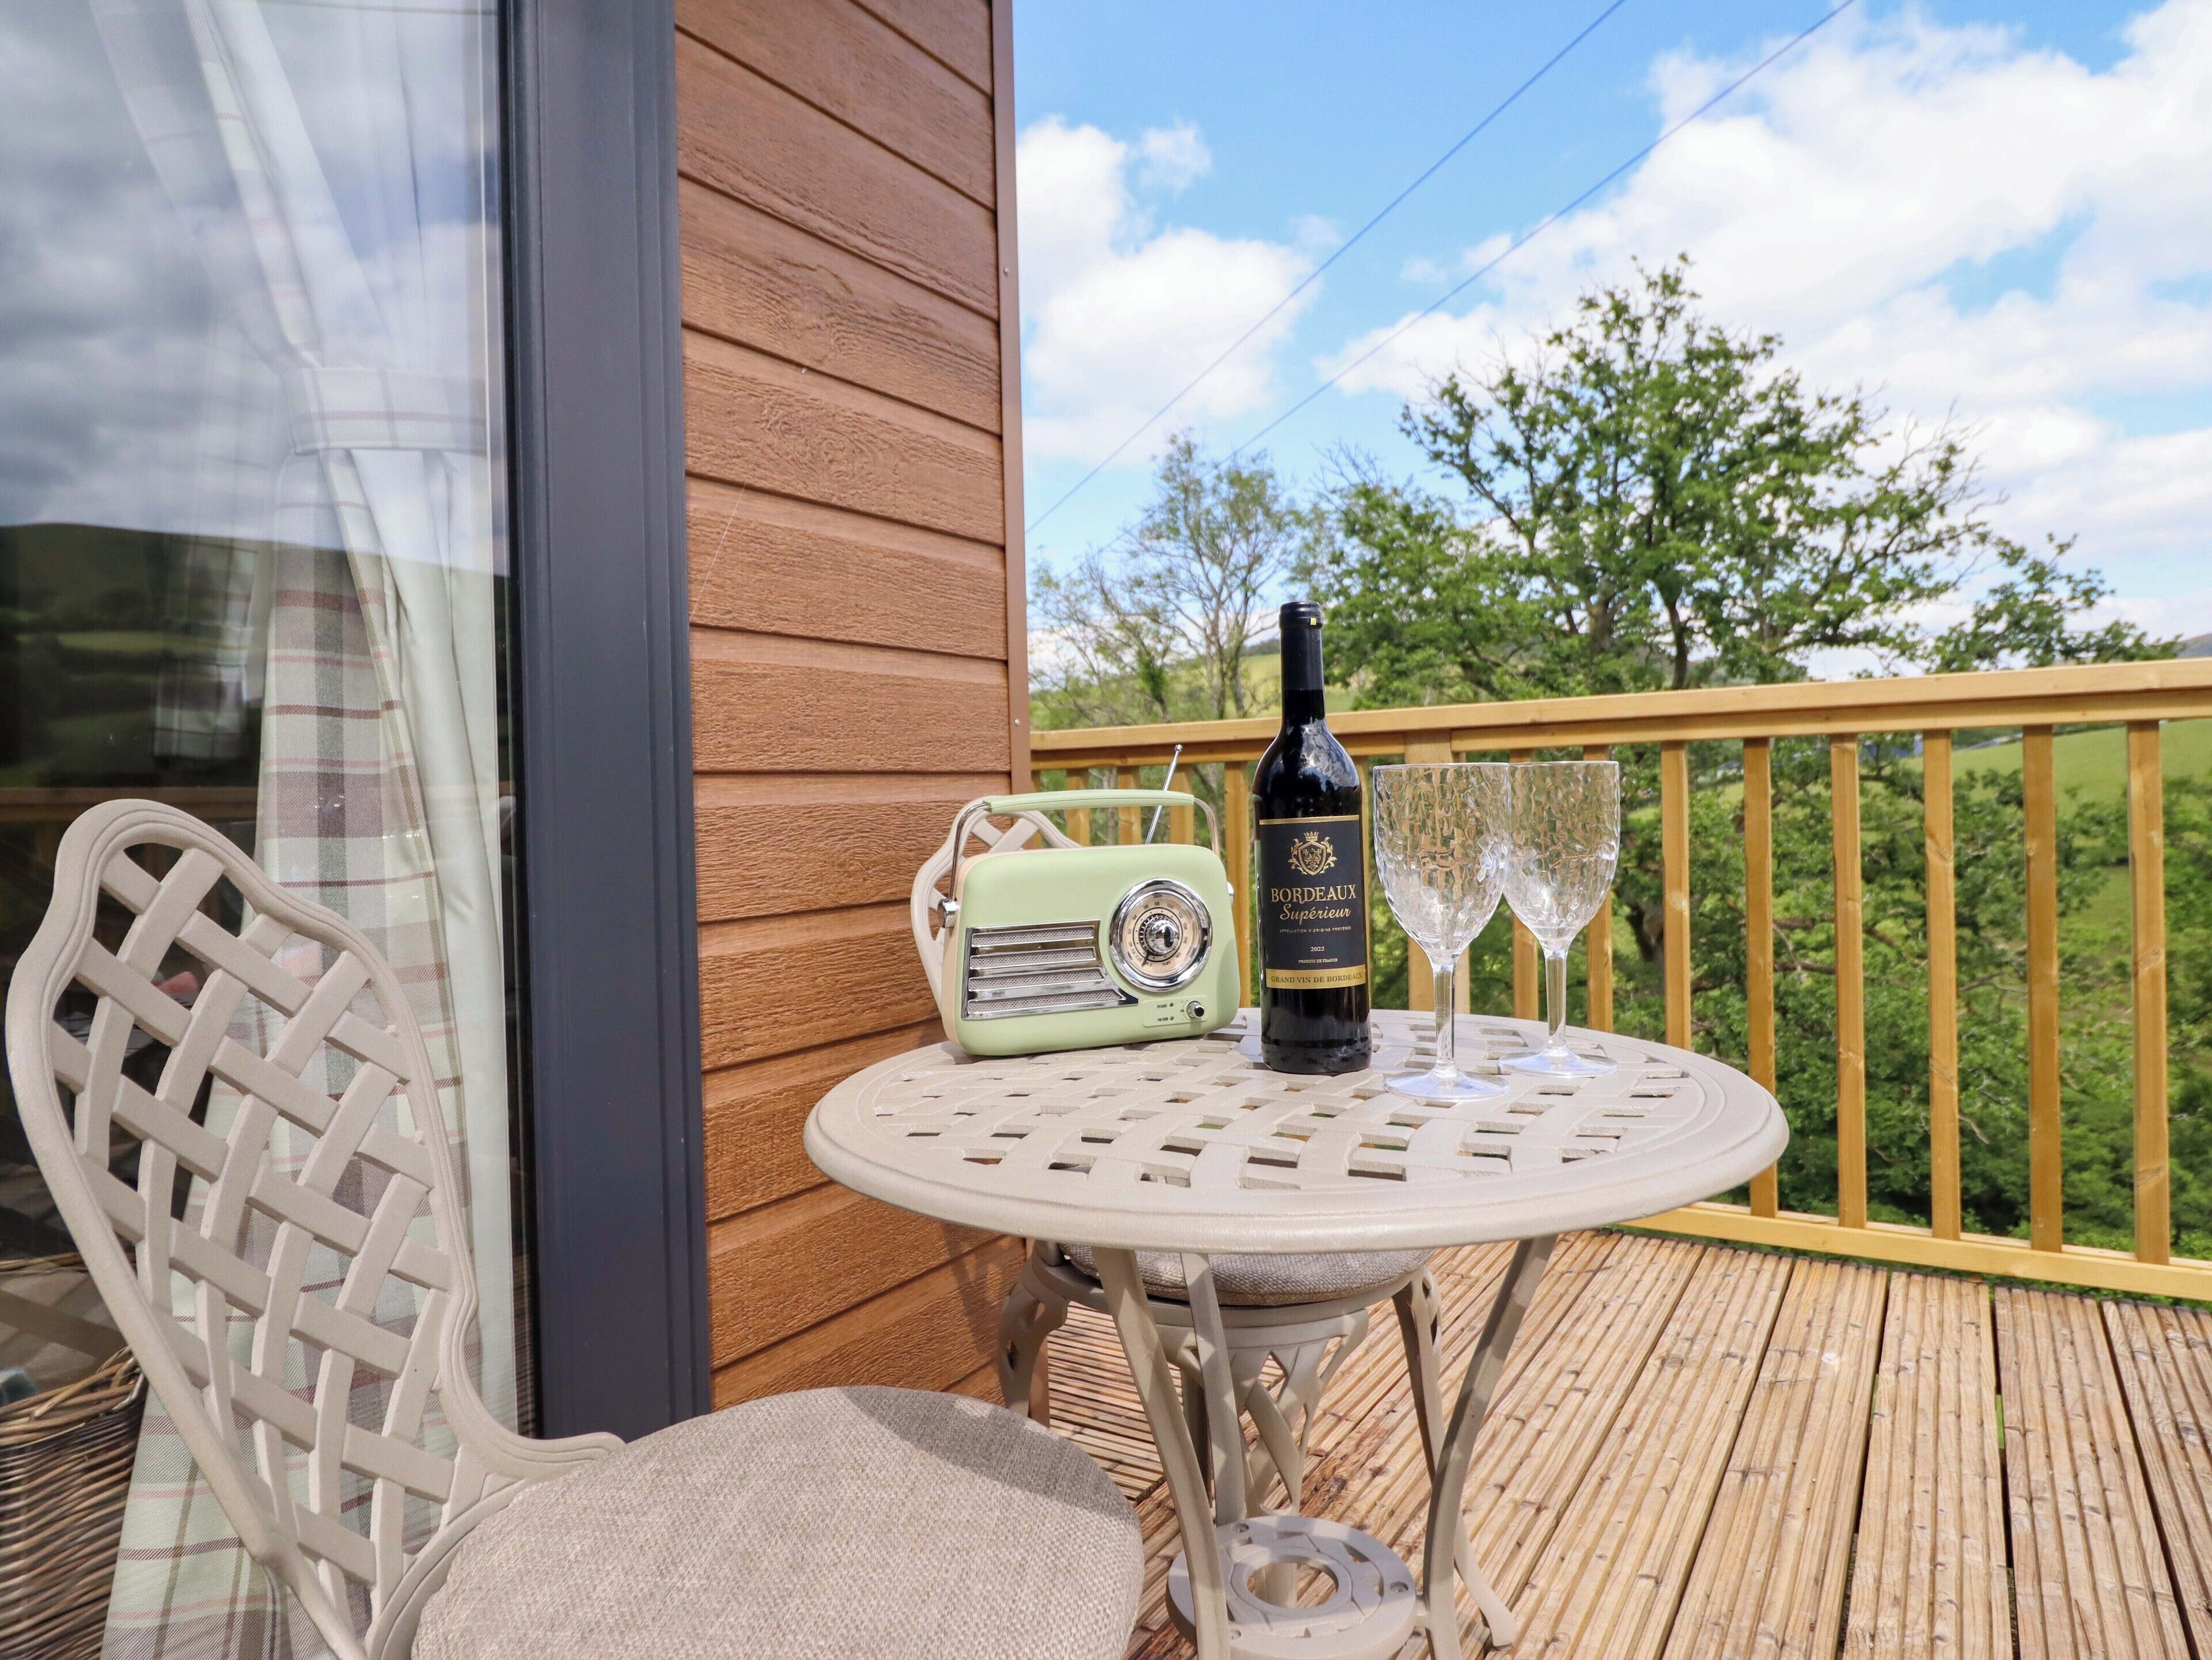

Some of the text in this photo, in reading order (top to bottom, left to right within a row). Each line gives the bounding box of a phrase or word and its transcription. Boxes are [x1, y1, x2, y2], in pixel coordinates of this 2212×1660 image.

[1271, 884, 1357, 904] BORDEAUX
[1279, 904, 1351, 925] Supérieur
[1327, 972, 1363, 982] BORDEAUX
